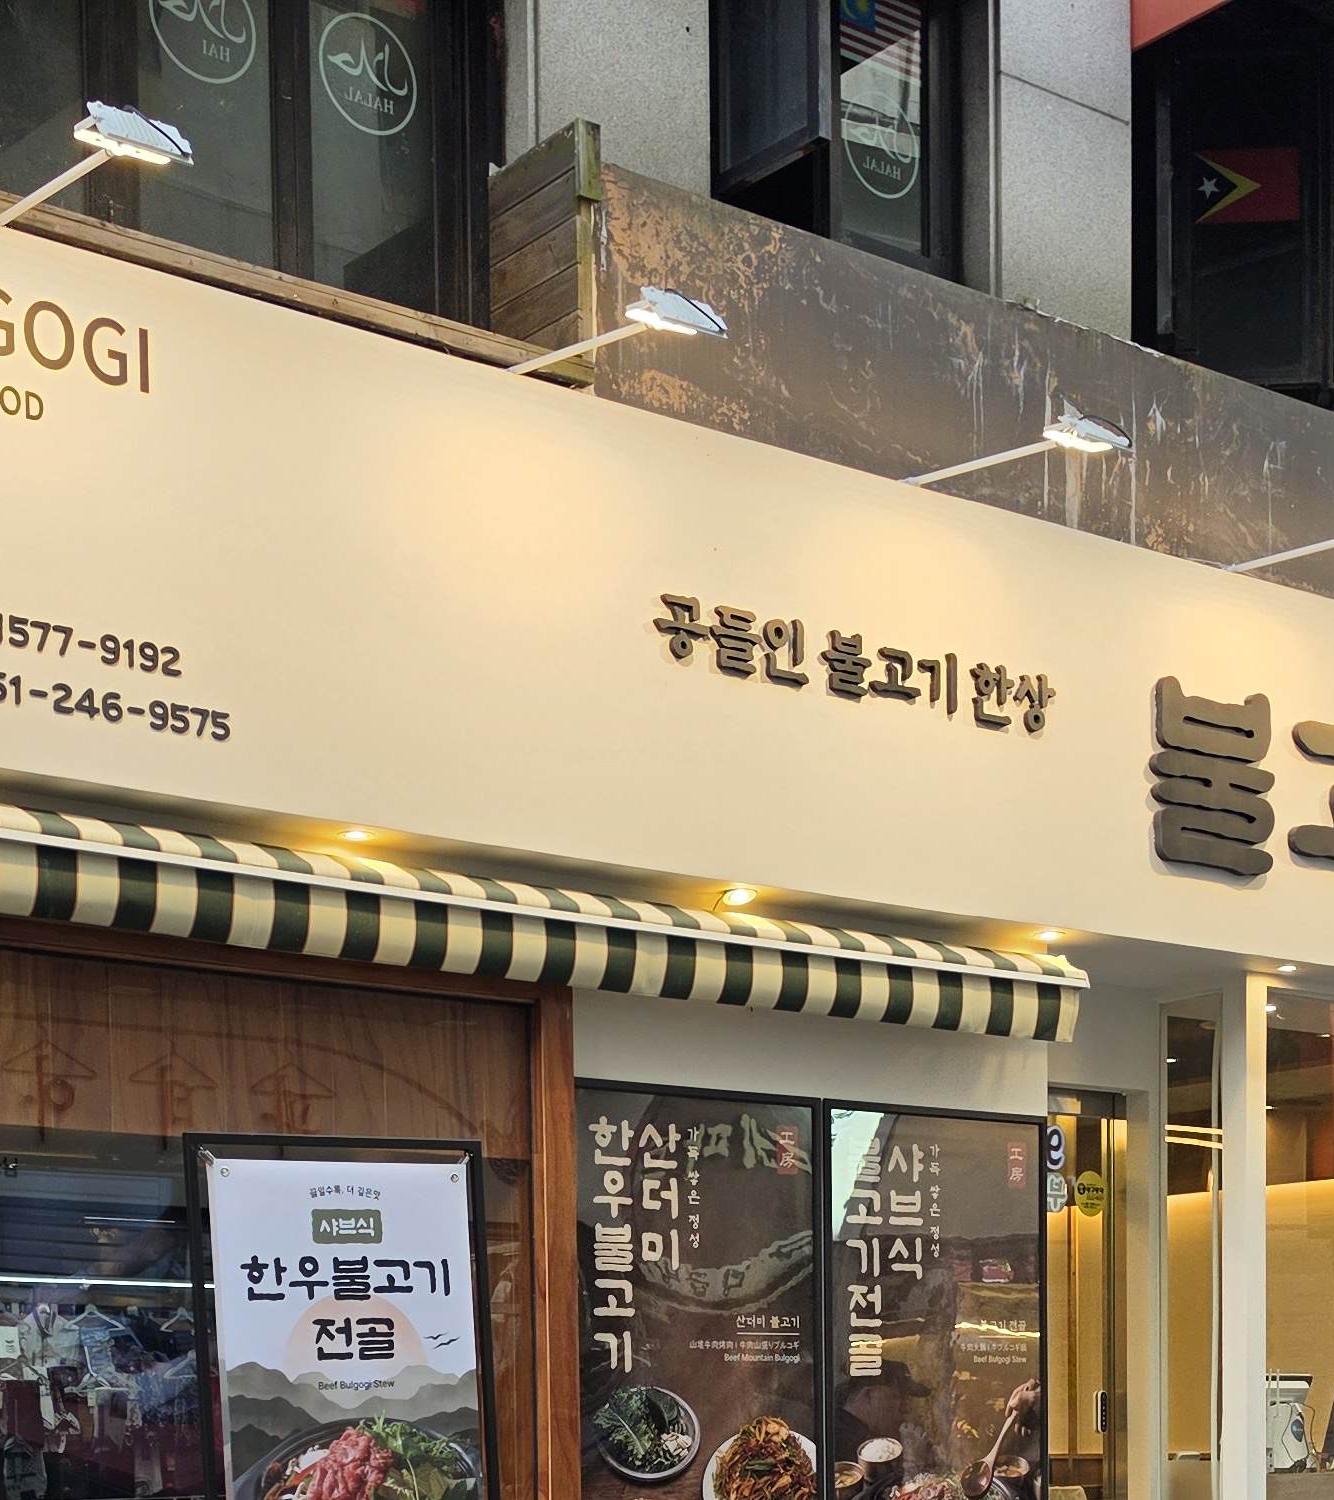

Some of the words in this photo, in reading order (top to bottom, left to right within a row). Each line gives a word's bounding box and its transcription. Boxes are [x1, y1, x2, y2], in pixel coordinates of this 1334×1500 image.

[653, 592, 810, 689] 공들인
[821, 629, 959, 715] 불고기
[969, 661, 1057, 734] 한상
[346, 1185, 355, 1196] 더
[638, 1122, 682, 1272] 산더미
[887, 1142, 925, 1281] 샤브식
[319, 1217, 375, 1237] 샤브식
[587, 1115, 636, 1374] 한우불고기
[687, 1213, 701, 1250] 정성
[928, 1225, 941, 1259] 정성
[240, 1255, 451, 1301] 한우불고기
[845, 1136, 885, 1378] 불고기전골
[312, 1317, 395, 1361] 전골
[735, 1314, 766, 1329] 산더미
[769, 1314, 801, 1330] 불고기
[318, 1380, 338, 1391] Beef
[340, 1379, 373, 1392] Bulgogi
[373, 1378, 395, 1389] Stew
